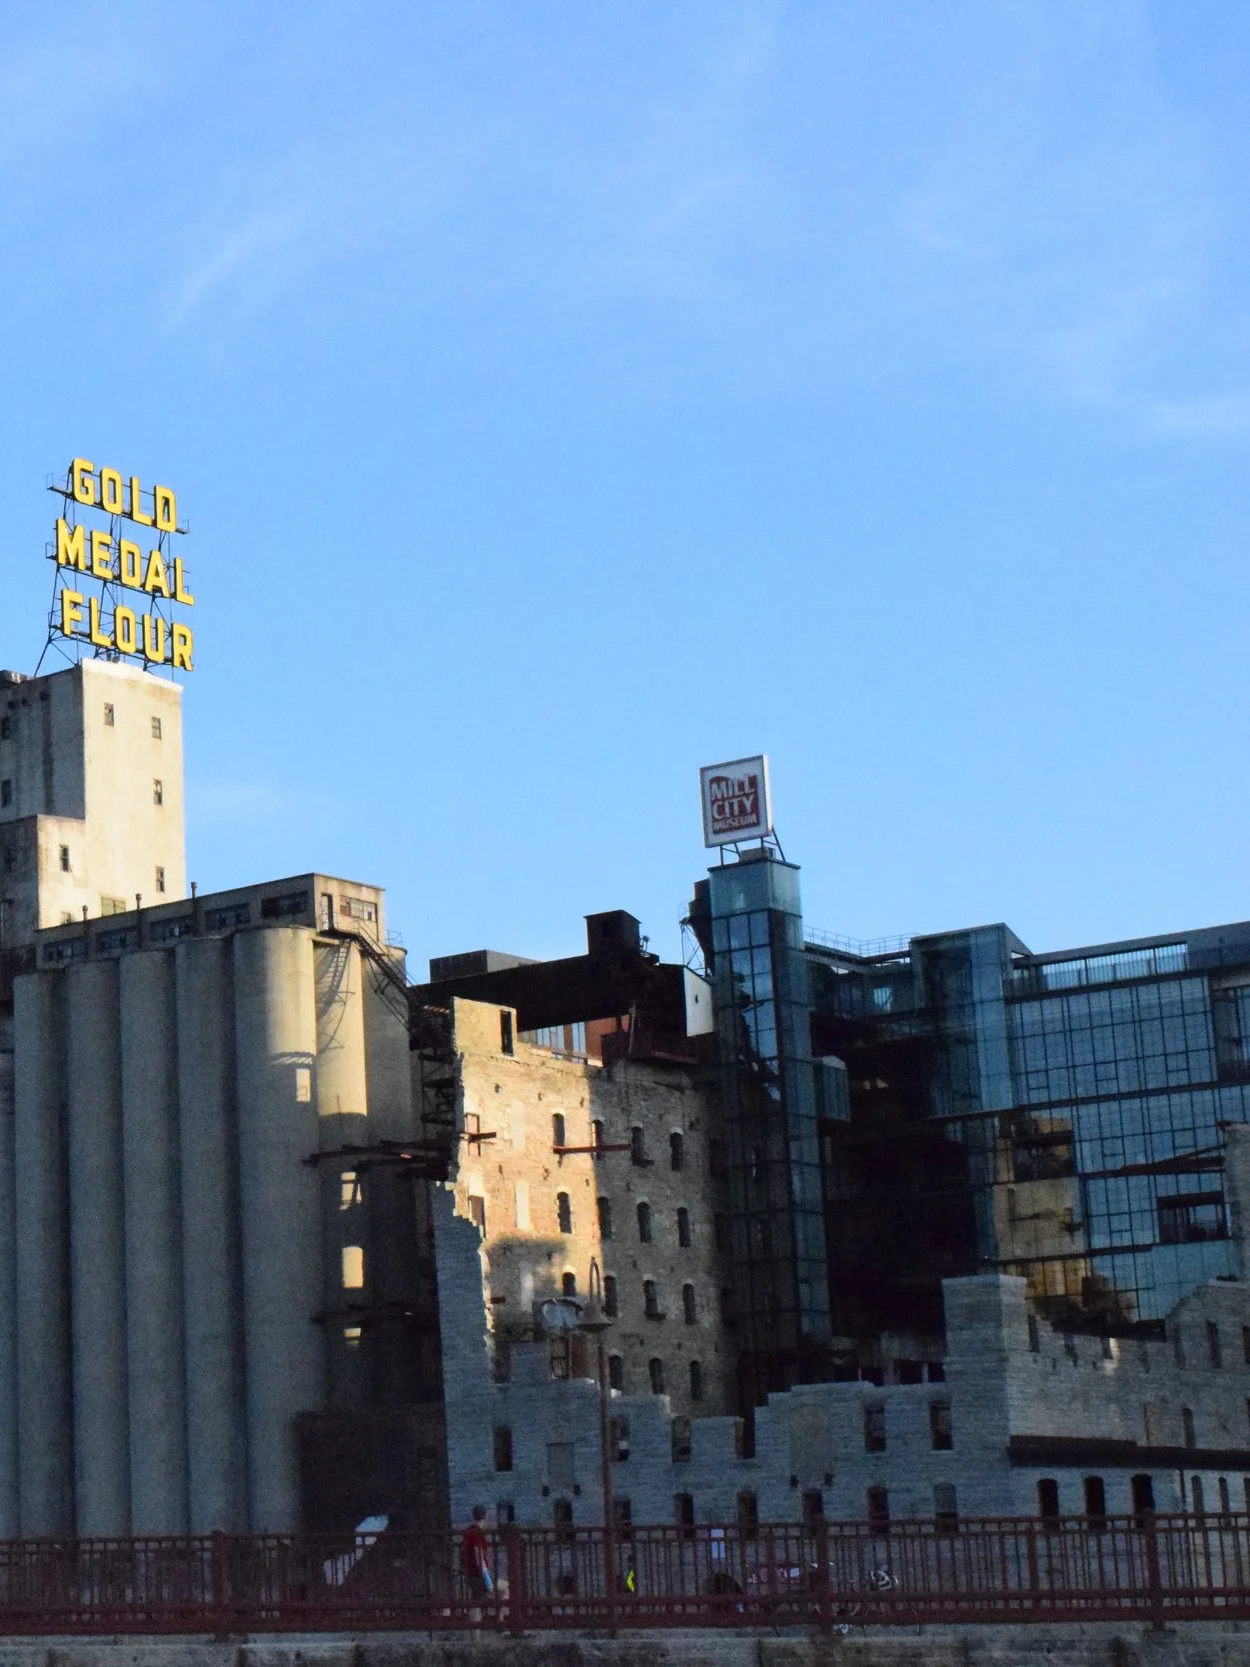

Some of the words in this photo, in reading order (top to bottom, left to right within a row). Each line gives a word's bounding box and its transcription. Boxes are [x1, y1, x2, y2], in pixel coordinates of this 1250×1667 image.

[71, 457, 177, 533] GOLD
[56, 517, 196, 606] MEDAL
[60, 588, 194, 672] FLOUR
[710, 773, 756, 800] MILL
[711, 795, 756, 820] CITY
[713, 814, 758, 832] MUSEUM
